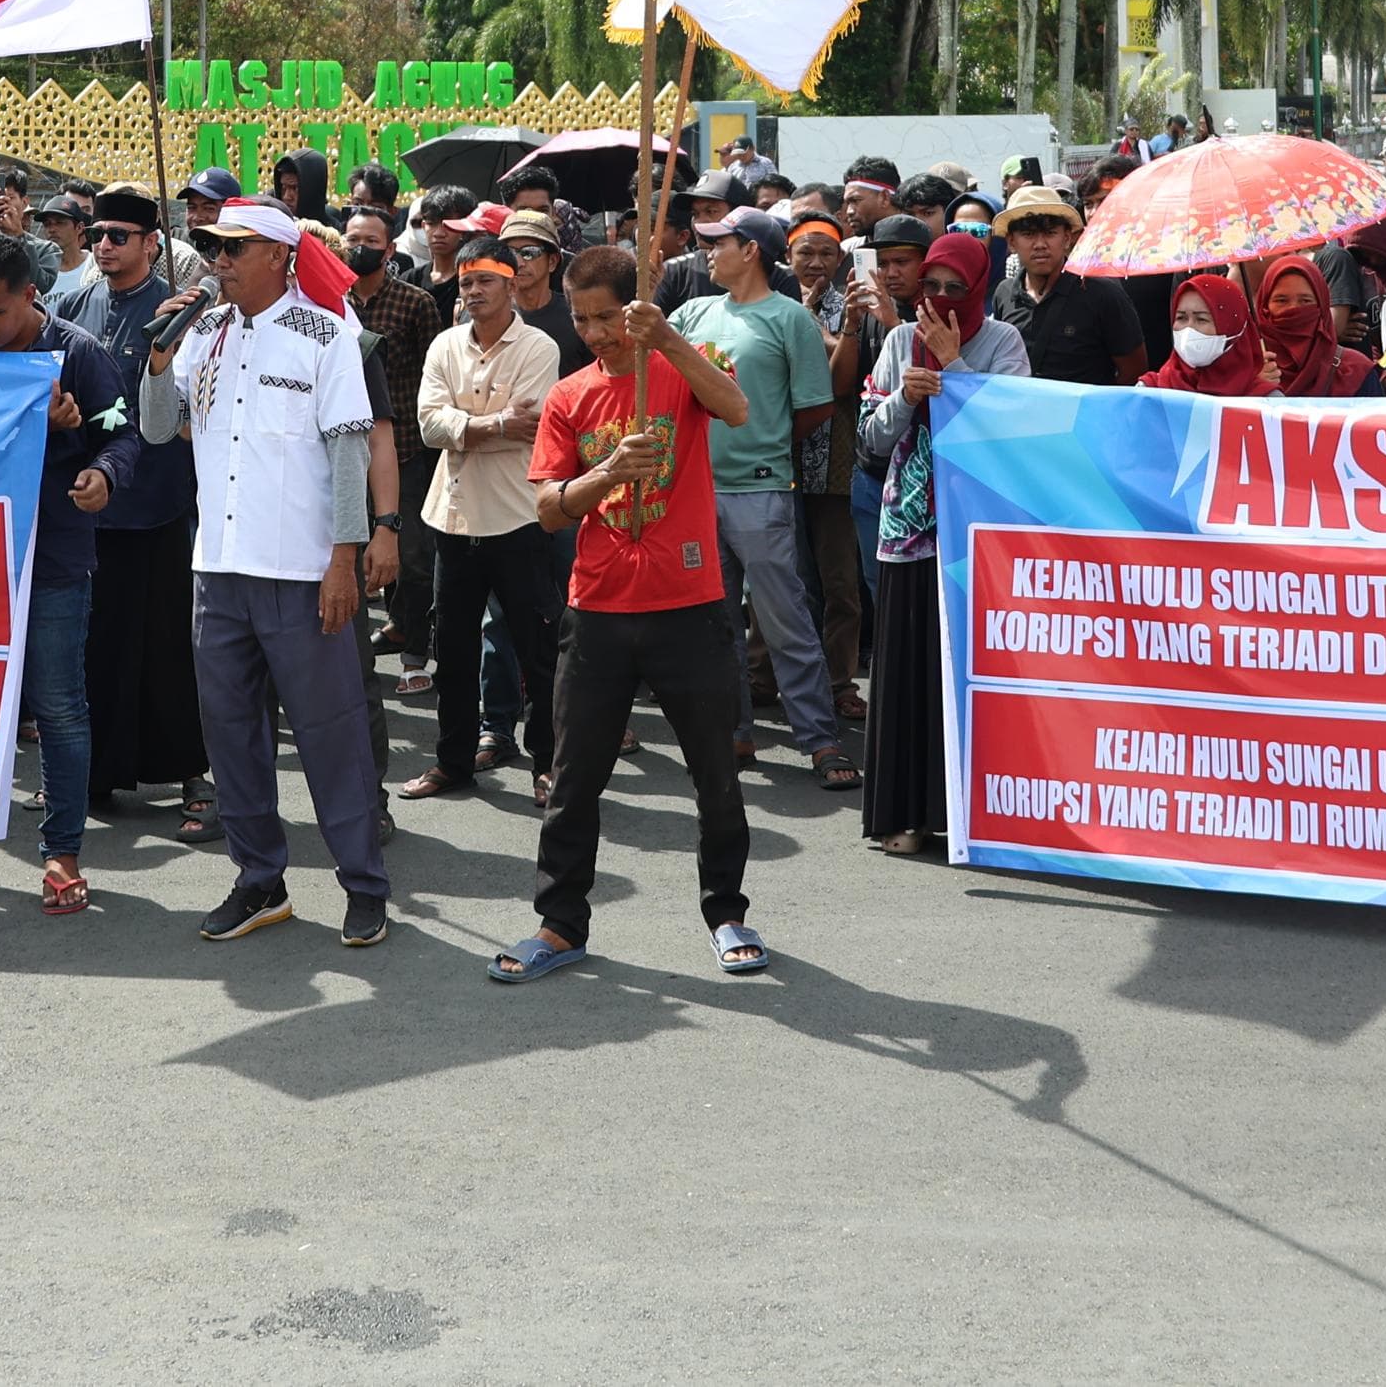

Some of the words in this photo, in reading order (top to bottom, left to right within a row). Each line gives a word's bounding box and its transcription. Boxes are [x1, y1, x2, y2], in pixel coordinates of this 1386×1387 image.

[166, 60, 344, 111] MASJID
[375, 60, 515, 110] AGUNG
[1012, 557, 1114, 603] KEJARI
[1120, 564, 1205, 610] HULU
[1210, 568, 1336, 617] SUNGAI
[985, 610, 1125, 660] KORUPSI
[1132, 619, 1211, 666] YANG
[1219, 624, 1354, 674] TERJADI
[1094, 726, 1187, 777] KEJARI
[1191, 734, 1261, 784] HULU
[1265, 740, 1370, 792] SUNGAI
[985, 772, 1091, 824] KORUPSI
[1097, 784, 1168, 833] YANG
[1173, 790, 1283, 843] TERJADI
[1289, 800, 1320, 846] DI
